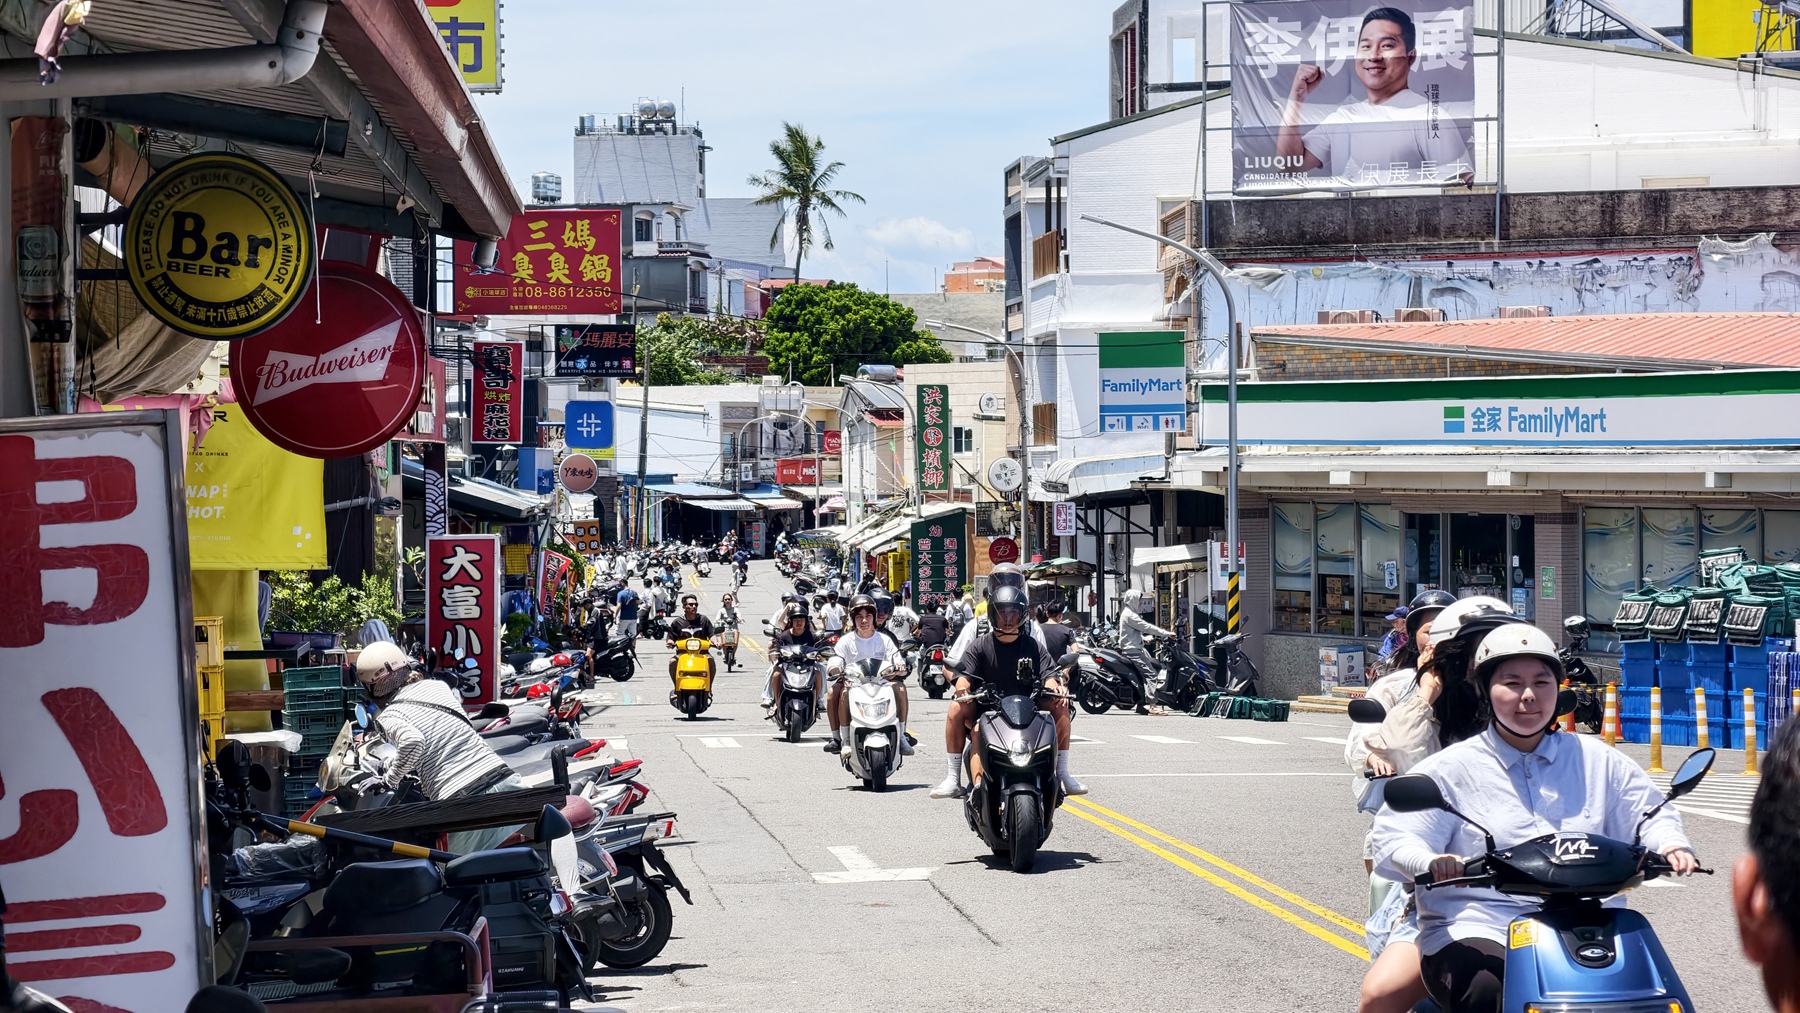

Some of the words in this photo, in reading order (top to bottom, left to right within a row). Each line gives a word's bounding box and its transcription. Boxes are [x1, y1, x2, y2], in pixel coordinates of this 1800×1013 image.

[435, 16, 485, 73] 市
[1244, 9, 1468, 79] 李伊展
[1243, 155, 1305, 170] LIUQIU
[1357, 158, 1469, 185] 伊展長才
[190, 172, 230, 186] DRINK
[234, 172, 248, 186] IF
[1243, 172, 1290, 181] CANDIDATE
[1291, 171, 1309, 180] FOR
[163, 180, 187, 201] NOT
[250, 181, 274, 205] YOU
[151, 201, 165, 219] DO
[270, 205, 290, 229] ARE
[166, 210, 273, 269] Bar
[281, 232, 292, 241] A
[523, 218, 597, 252] 三媽
[141, 220, 156, 271] PLEASE
[166, 260, 231, 279] BEER
[272, 243, 293, 285] MINOR
[511, 251, 613, 284] 臭臭鍋
[525, 286, 612, 298] 08-8612350
[256, 344, 393, 390] Budweiser
[1102, 378, 1182, 395] FamilyMart
[1471, 406, 1502, 432] 全家
[1508, 406, 1607, 437] FamilyMart
[186, 485, 220, 498] NAP
[186, 505, 226, 519] HOT.
[928, 525, 943, 537] 幼
[918, 538, 957, 550] 普通
